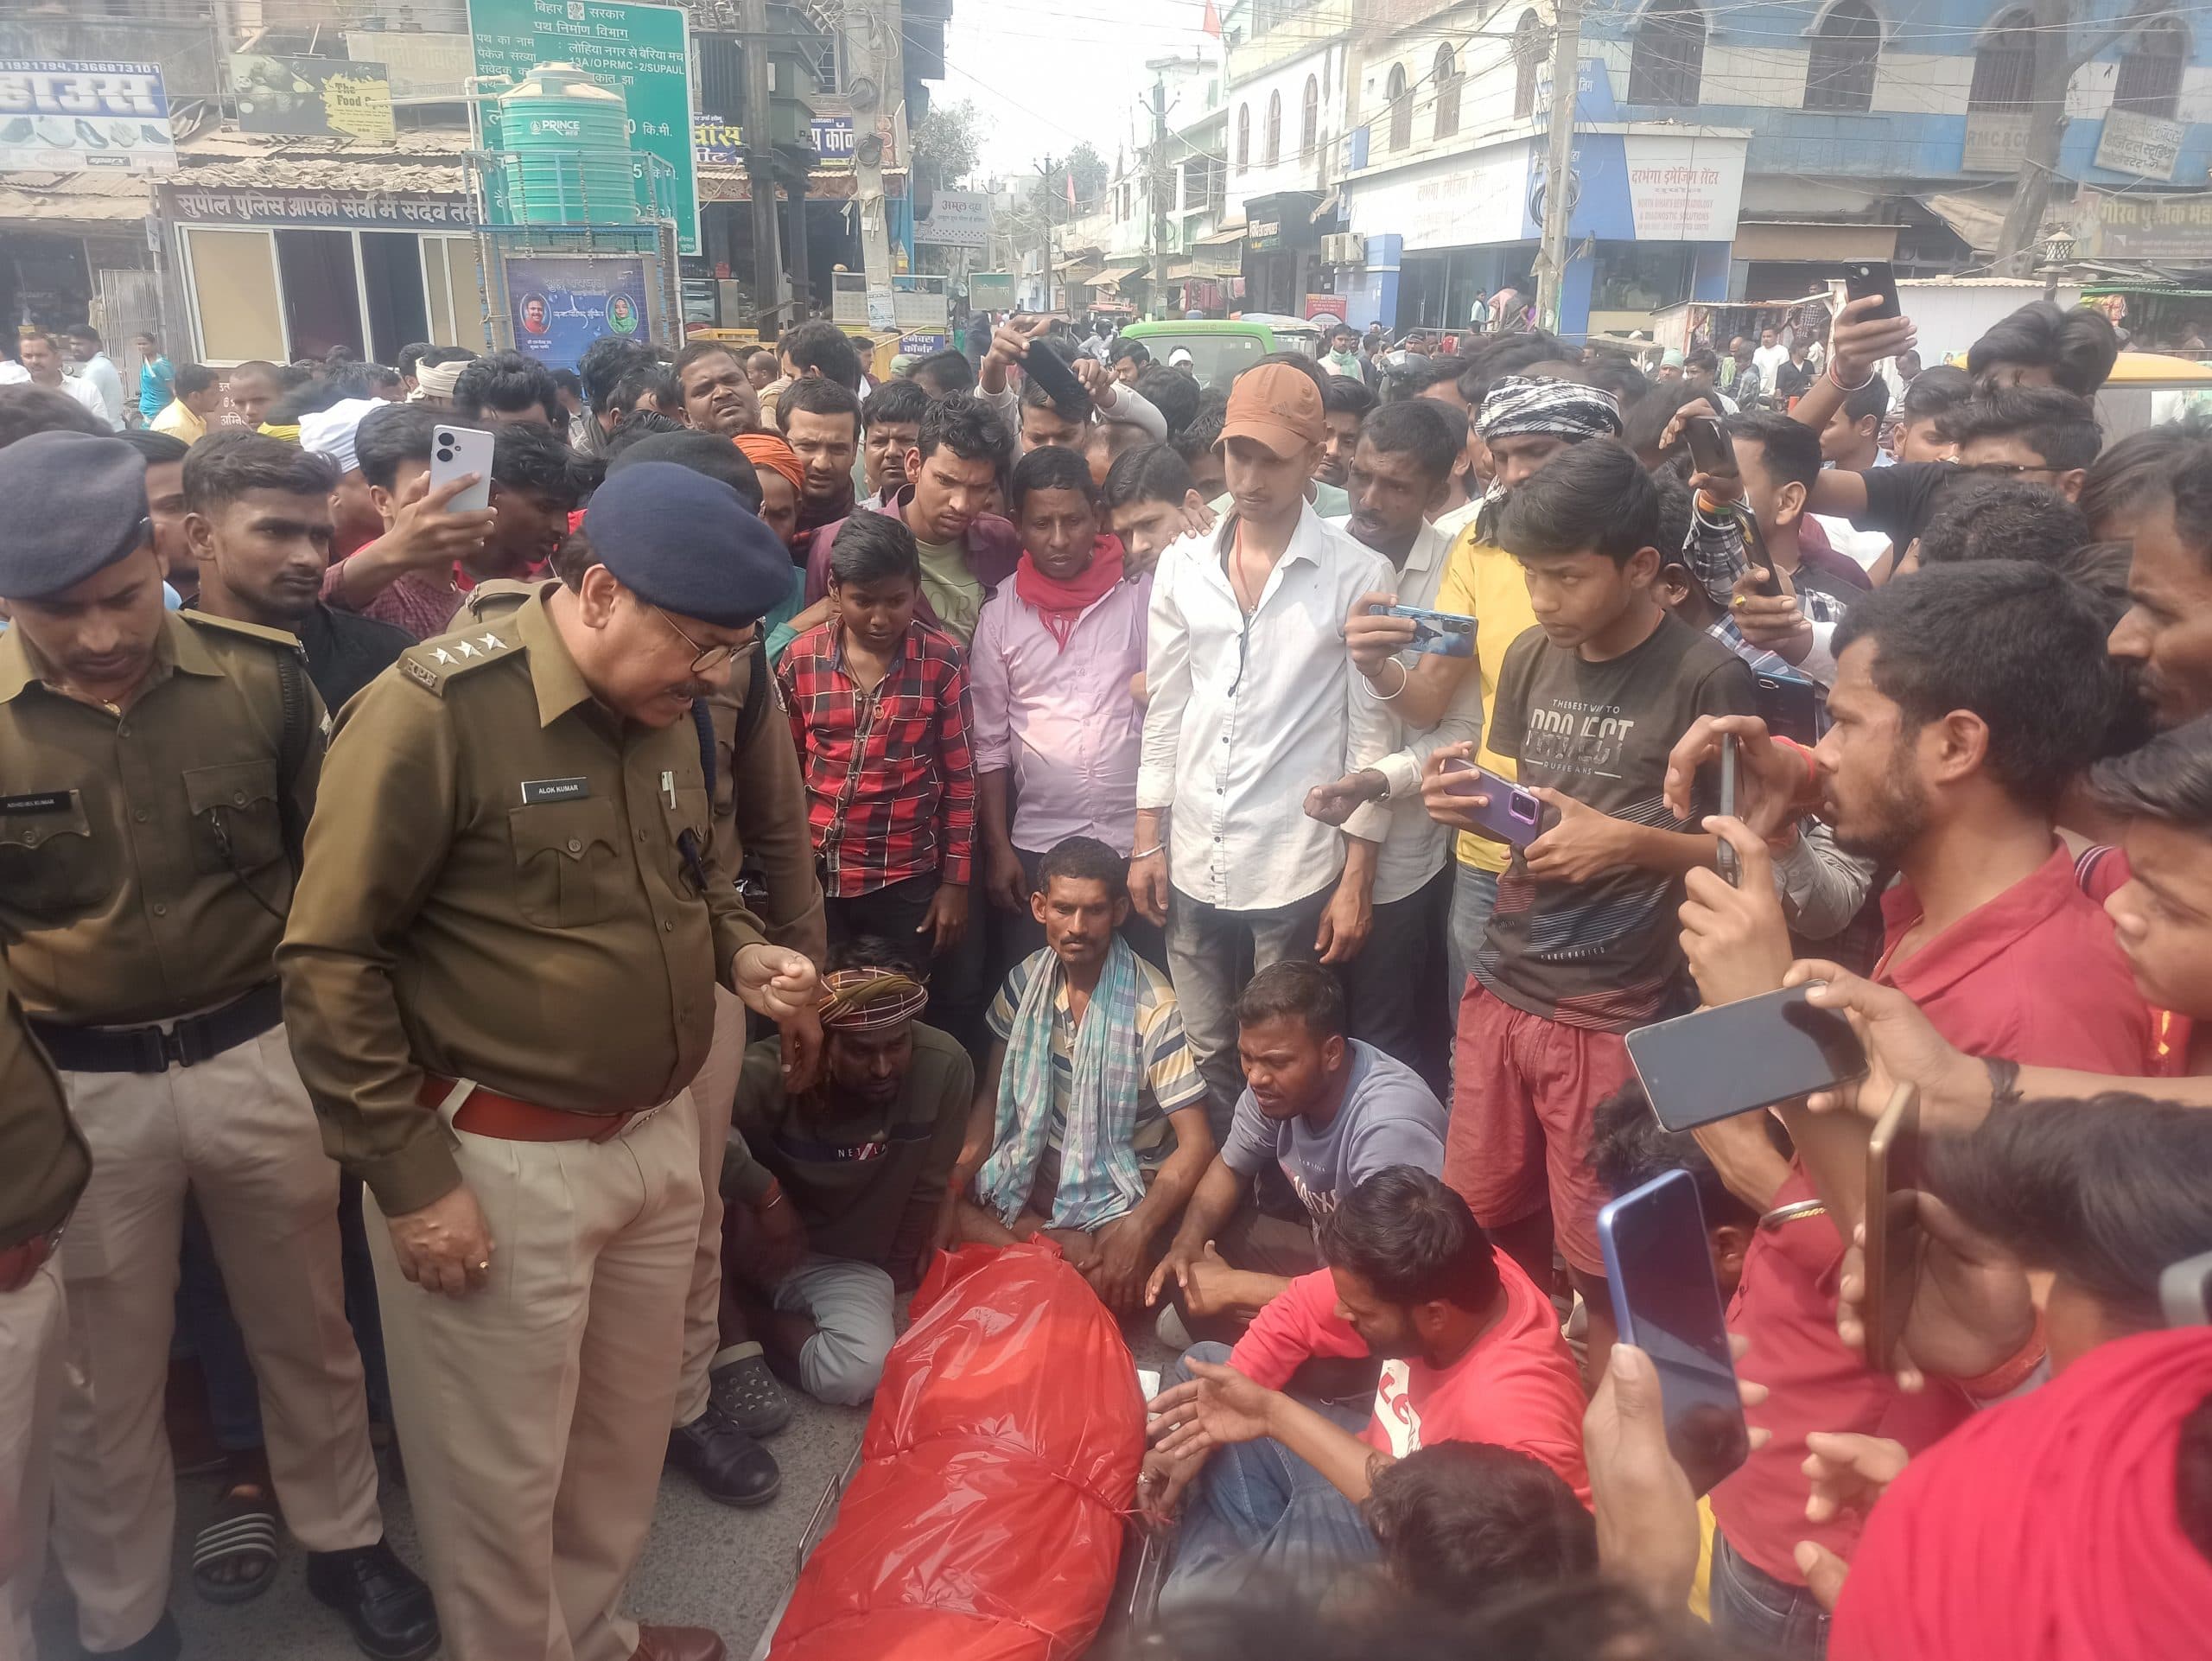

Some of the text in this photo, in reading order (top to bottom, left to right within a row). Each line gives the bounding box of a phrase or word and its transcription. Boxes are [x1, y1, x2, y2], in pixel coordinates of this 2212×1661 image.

[534, 0, 626, 20] बिहार सरकार
[534, 20, 629, 39] पथ निर्माण विभाग
[476, 35, 492, 43] पथ
[498, 35, 512, 45] का
[516, 37, 535, 48] नाम
[568, 41, 602, 55] लोहिया
[604, 46, 626, 57] नगर
[628, 46, 638, 58] से
[477, 46, 504, 60] पैकेज
[335, 82, 356, 94] The
[337, 95, 362, 106] Food
[542, 119, 581, 136] PRINCE
[1631, 168, 1661, 184] दरभंगा
[175, 189, 232, 218] सुपौल
[232, 189, 286, 220] पुलिस
[288, 194, 339, 217] आपकी
[341, 193, 378, 219] सेवा
[400, 195, 448, 222] सदैव
[556, 784, 579, 792] KUMAR
